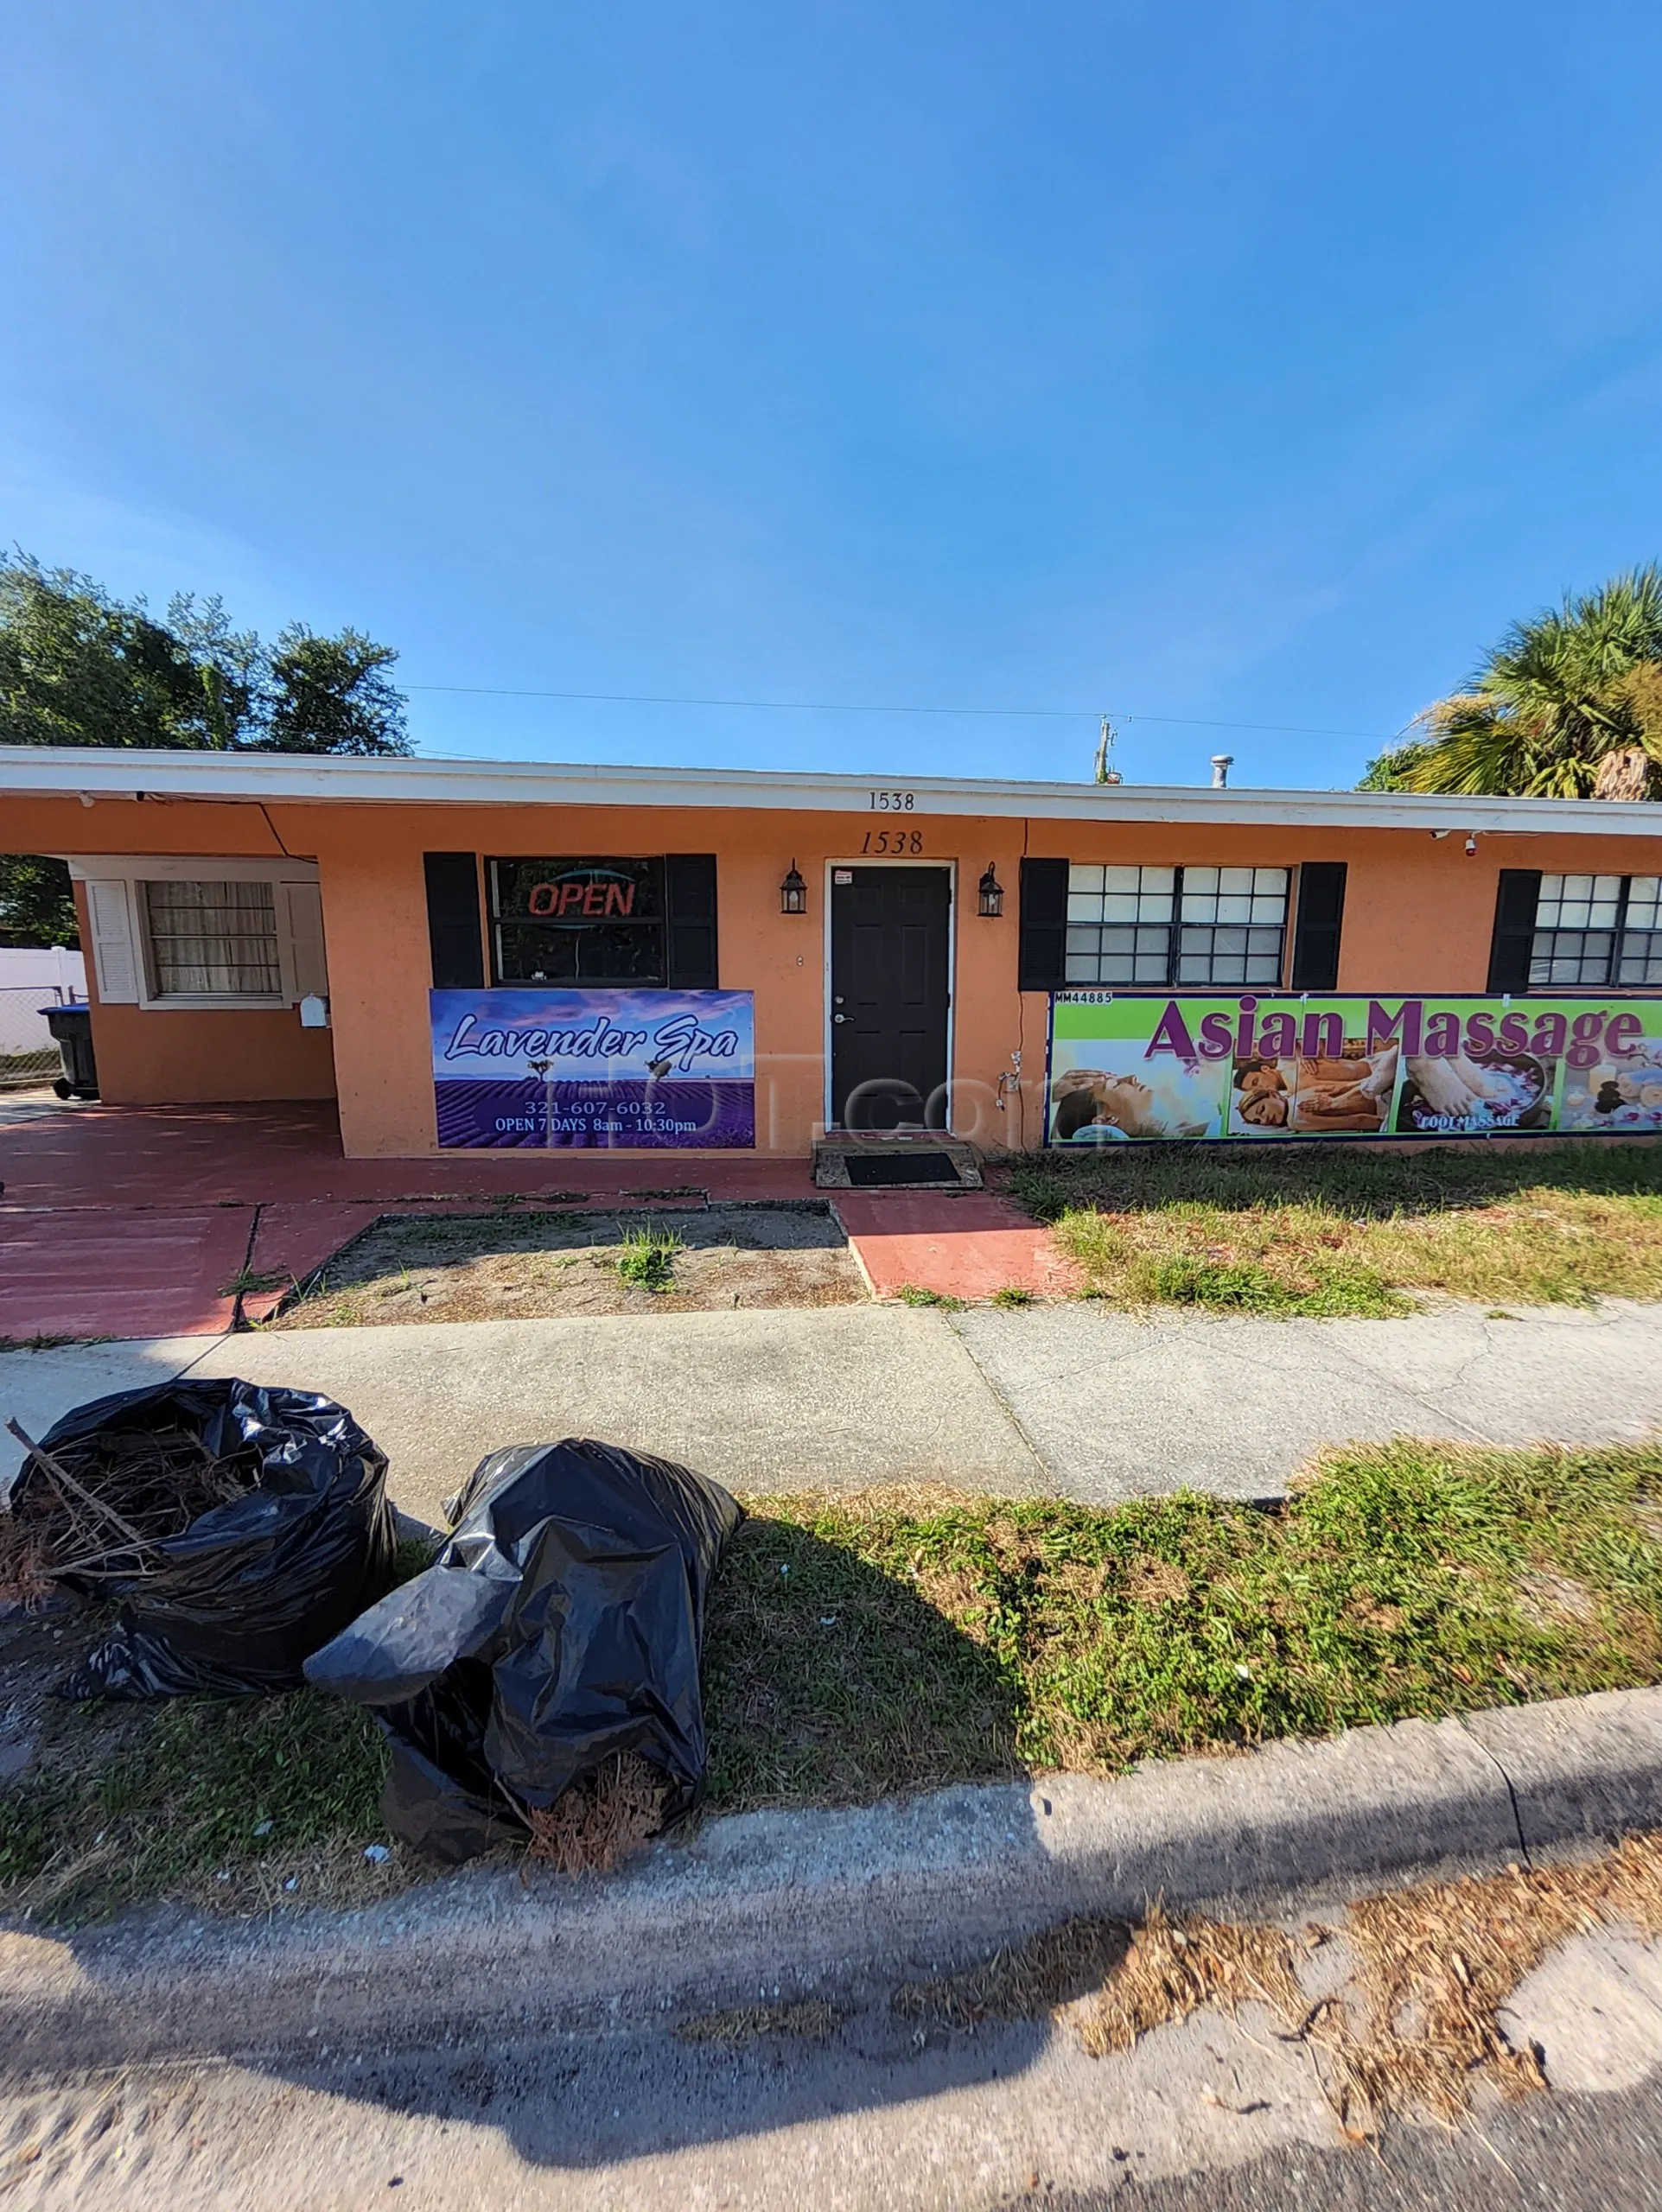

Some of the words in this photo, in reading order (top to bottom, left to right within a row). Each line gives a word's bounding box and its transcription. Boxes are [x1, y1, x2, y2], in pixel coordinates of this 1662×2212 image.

[869, 791, 914, 810] 1538
[860, 830, 923, 855] 1538
[528, 883, 635, 917] OPEN
[1055, 992, 1112, 1004] MM44885
[445, 1014, 646, 1060] Lavender
[653, 1014, 739, 1071] Spa
[1144, 995, 1343, 1060] Asian
[1366, 1001, 1644, 1070] Massage
[525, 1101, 666, 1115] 321-607-6032
[495, 1118, 533, 1131] OPEN
[538, 1118, 546, 1131] 7
[551, 1118, 586, 1131] DAYS
[593, 1118, 623, 1131] 8am
[636, 1117, 696, 1135] 10:30pm
